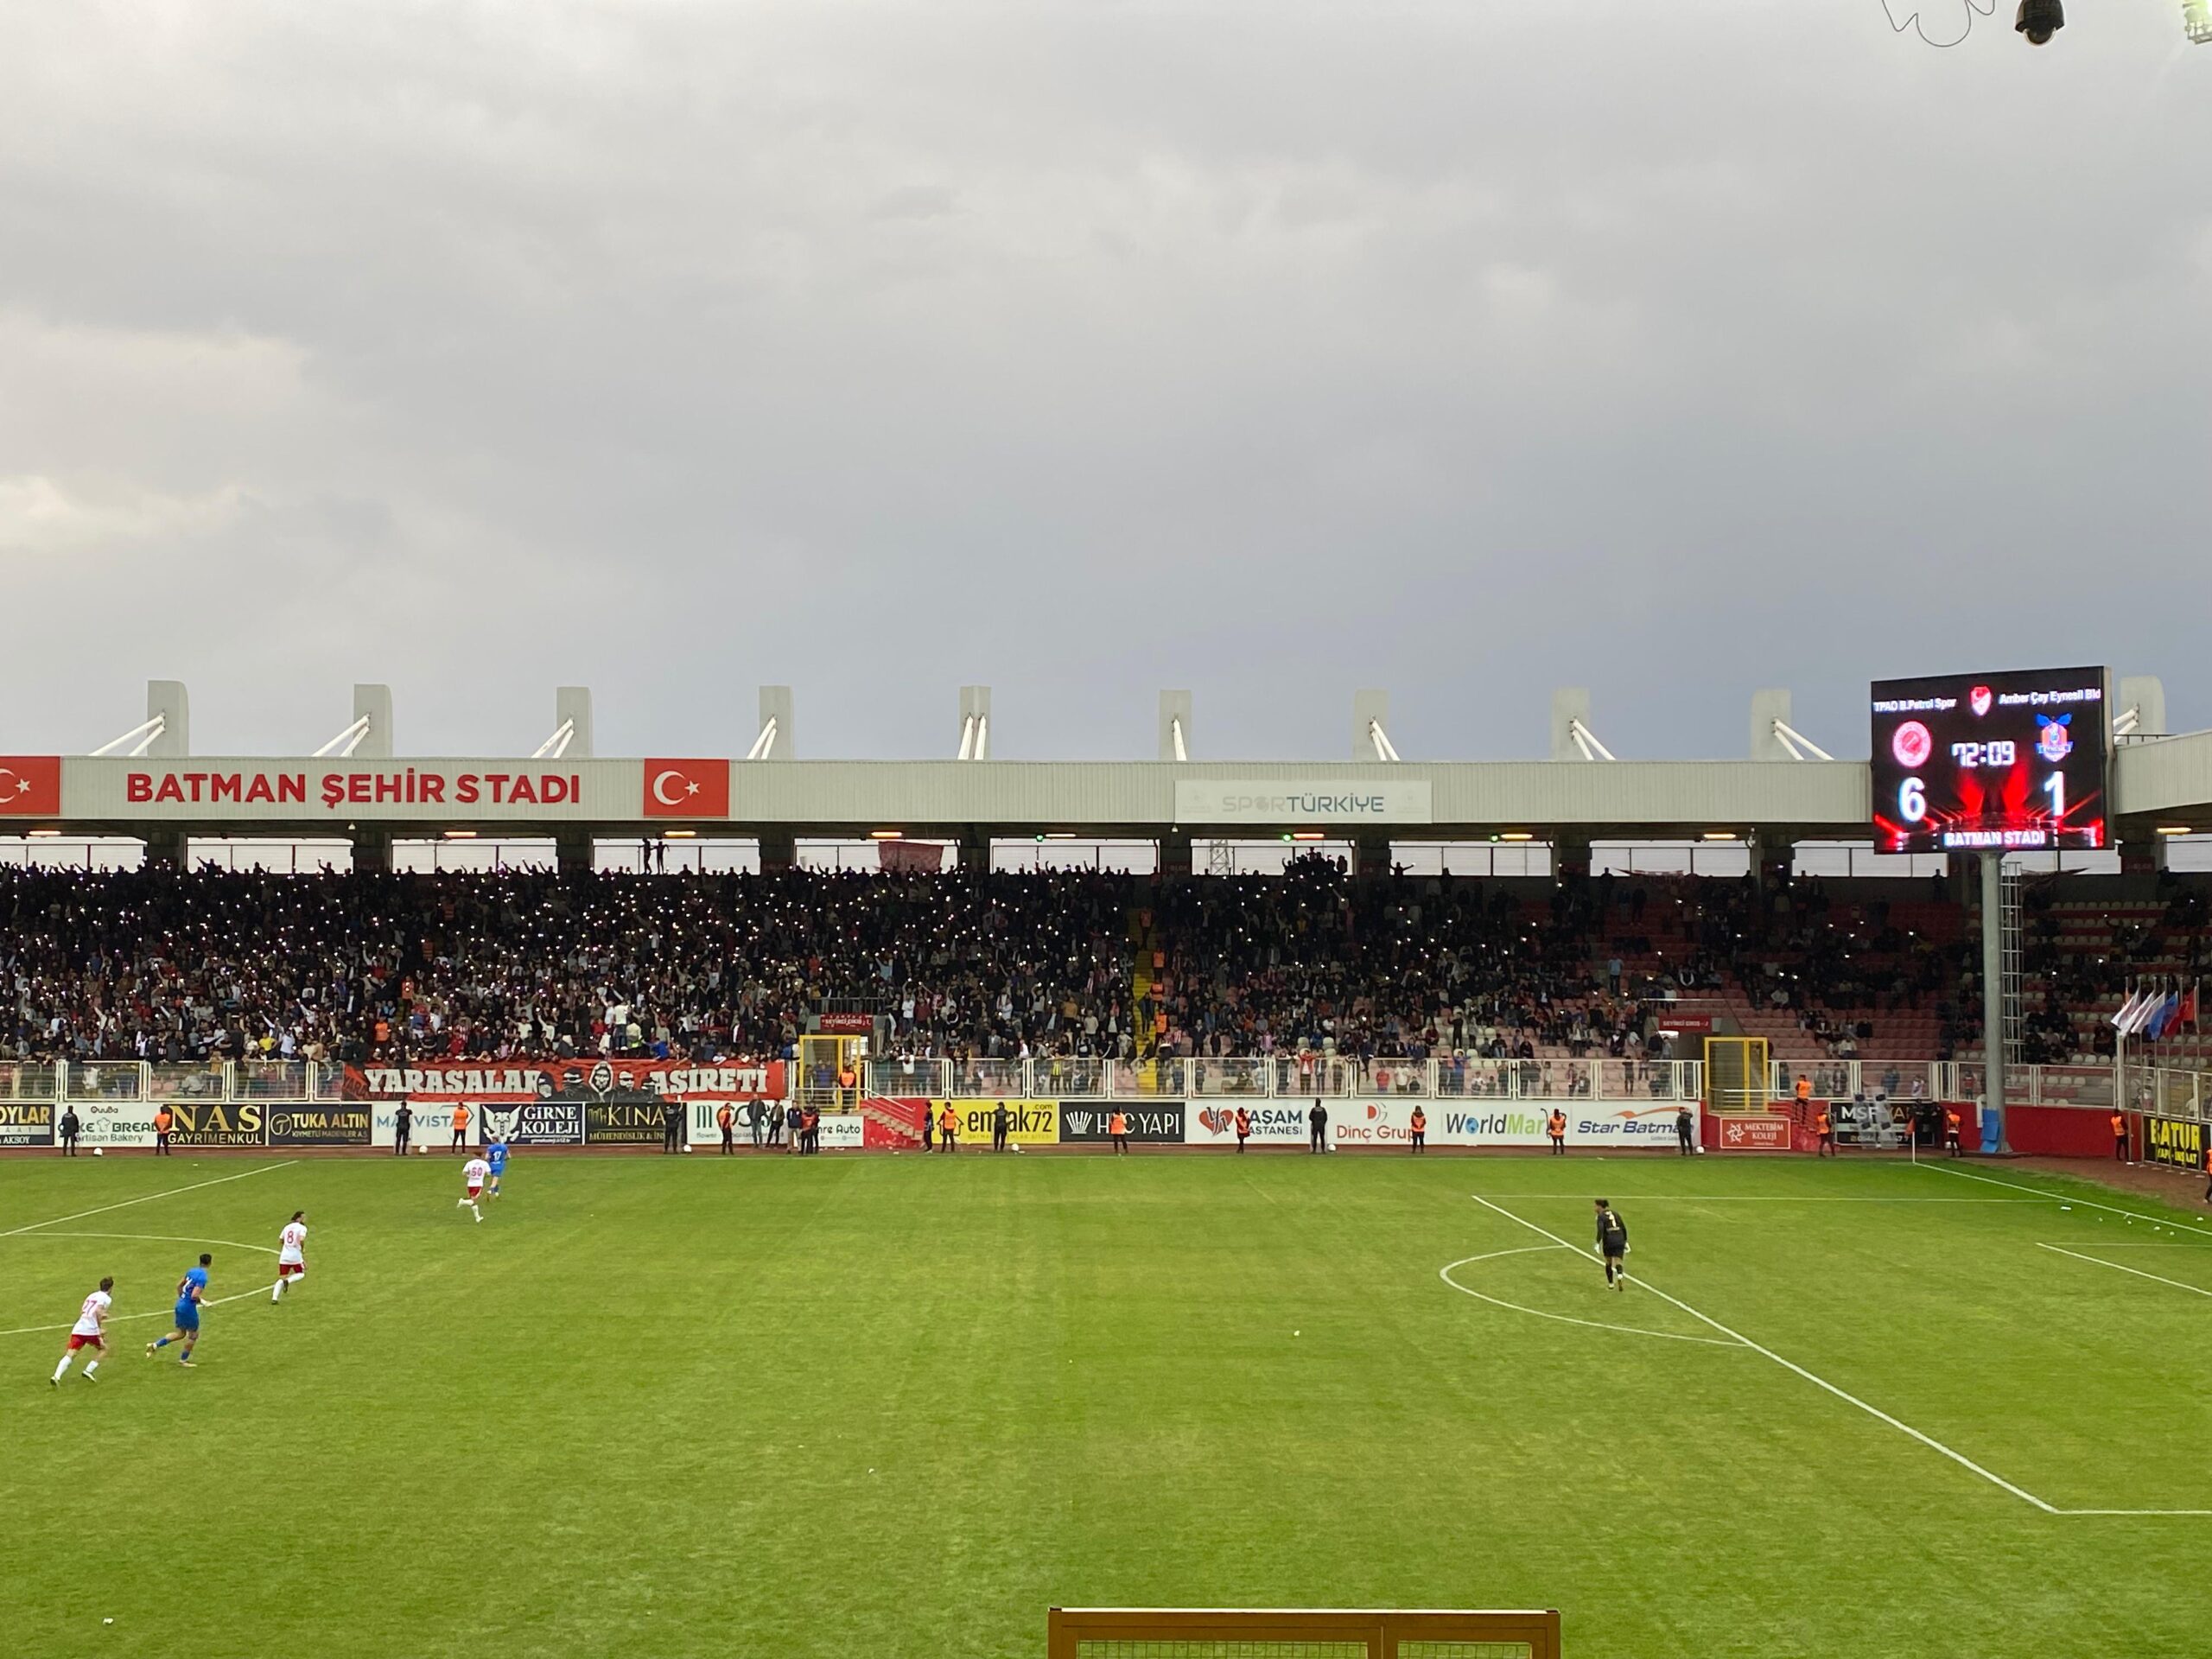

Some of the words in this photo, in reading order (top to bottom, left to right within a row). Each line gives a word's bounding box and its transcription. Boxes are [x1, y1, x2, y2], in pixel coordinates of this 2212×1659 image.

[1872, 701, 1897, 712] TPAO
[1935, 698, 1957, 710] Spor
[1998, 693, 2030, 705] Amber
[2031, 691, 2049, 706] Çay
[2084, 688, 2101, 700] Bld
[1952, 741, 2016, 766] 72:09
[127, 773, 306, 803] BATMAN
[321, 767, 445, 809] ŞEHİR
[455, 774, 580, 804] STADI
[2044, 771, 2065, 817] 1
[1898, 776, 1927, 822] 6
[1943, 831, 2002, 847] BATMAN
[2004, 830, 2045, 845] STADI
[364, 1068, 541, 1094] YARASALAR
[168, 1105, 262, 1132] NAS
[291, 1113, 327, 1128] TUKA
[331, 1113, 369, 1128] ALTIN
[1096, 1112, 1135, 1135] HC
[1138, 1113, 1179, 1135] YAPI
[836, 1124, 861, 1134] Auto
[1249, 1126, 1303, 1135] ASTANESİ
[1337, 1125, 1372, 1142] Dinç
[1377, 1125, 1413, 1141] Grup
[1578, 1121, 1619, 1134] Star
[3, 1136, 31, 1145] AKSOY
[111, 1134, 143, 1142] Bakery
[168, 1132, 263, 1145] GAYRİMENKUL
[287, 1230, 294, 1244] 8
